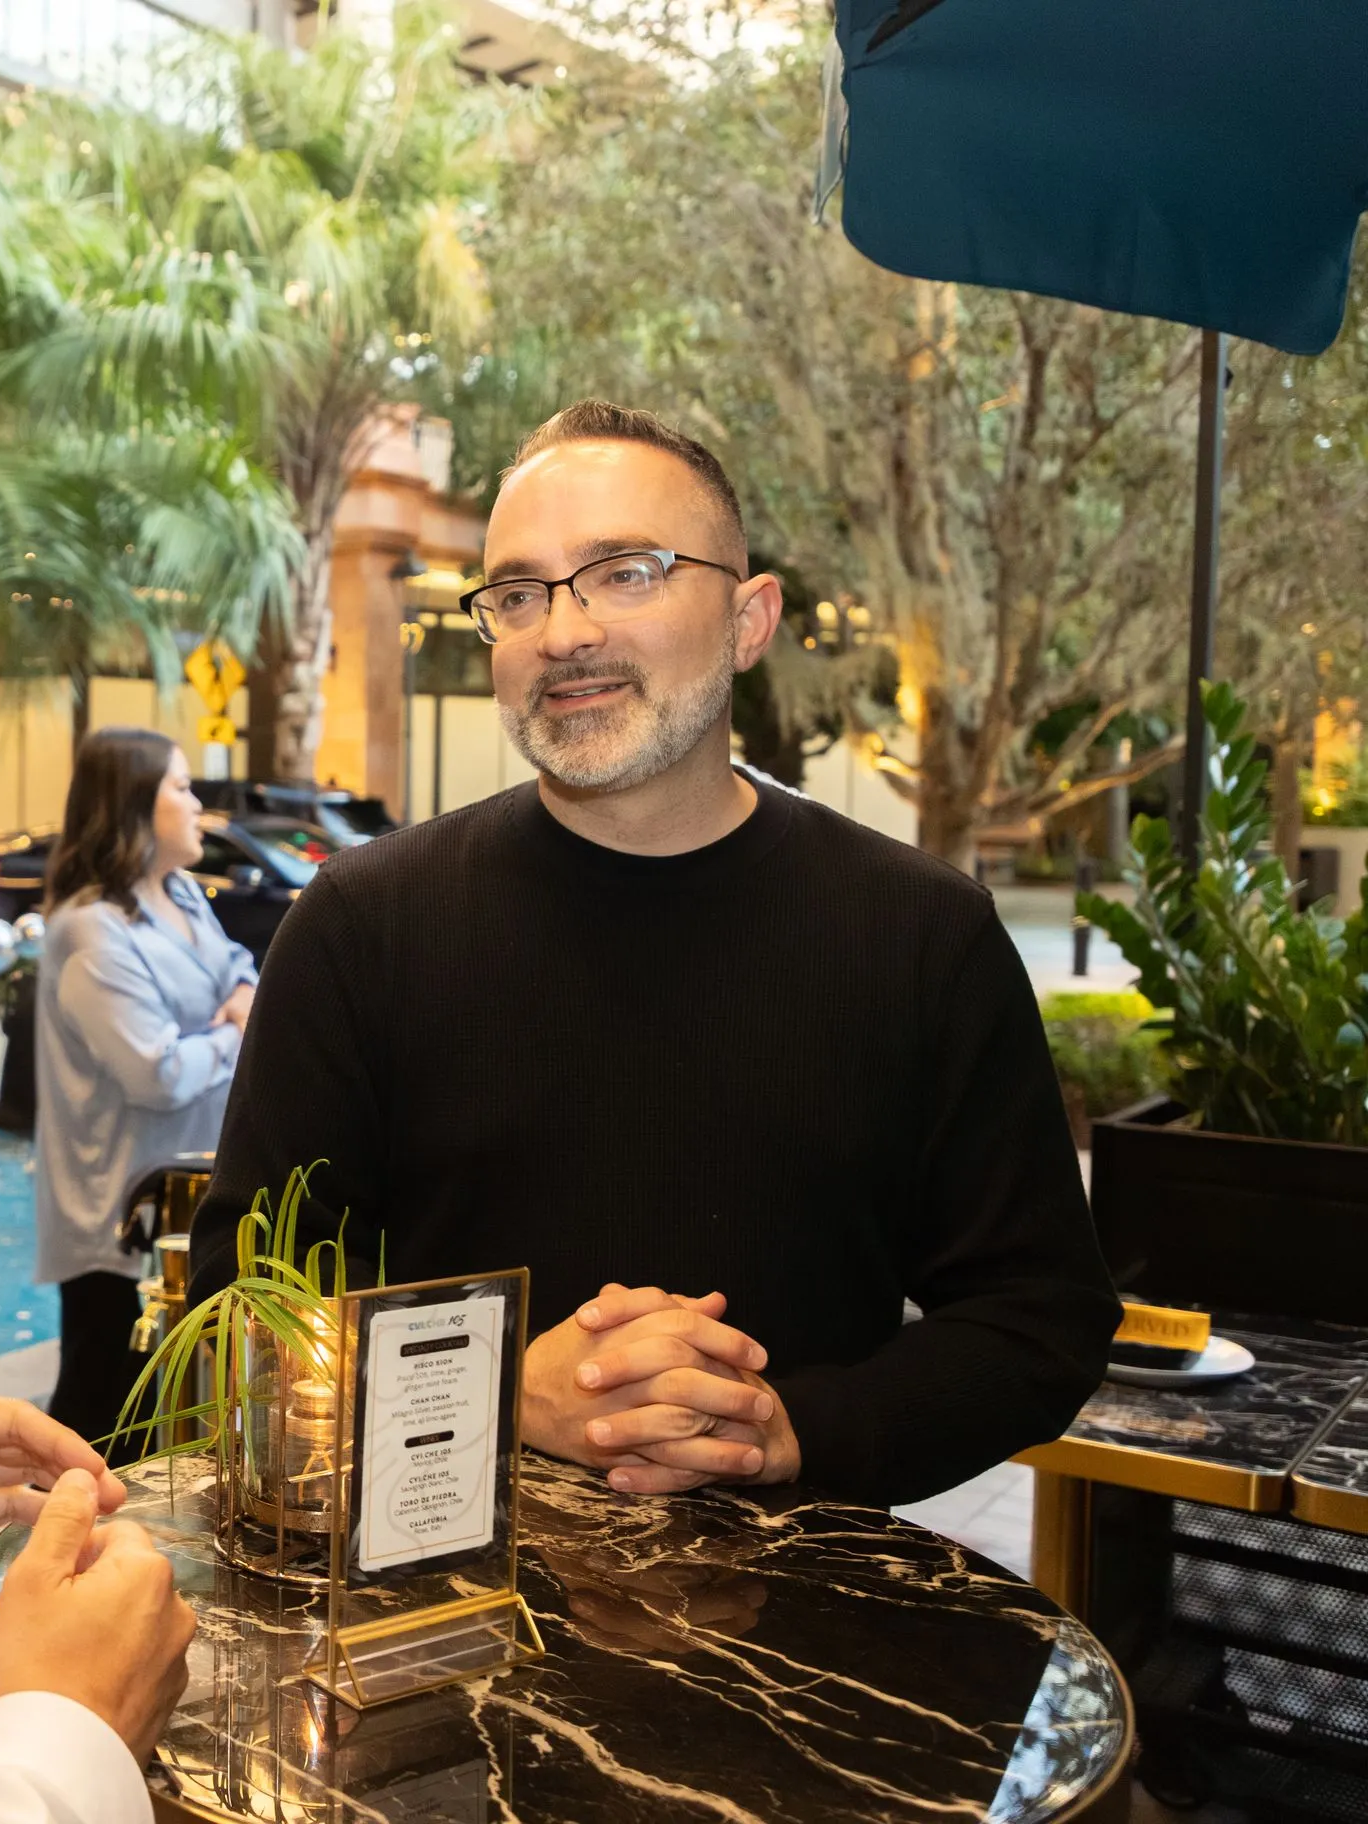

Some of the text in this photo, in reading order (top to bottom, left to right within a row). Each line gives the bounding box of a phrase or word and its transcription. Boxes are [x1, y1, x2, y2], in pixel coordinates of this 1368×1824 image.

[448, 1314, 466, 1327] 105
[414, 1360, 433, 1370] PISCO
[404, 1384, 424, 1394] ginger
[410, 1393, 450, 1405] CHAN CHAN
[434, 1456, 448, 1464] Chile
[400, 1484, 427, 1493] Sauvignon
[445, 1476, 459, 1484] Chile
[400, 1492, 457, 1508] TORO DE PIEDRA
[393, 1506, 420, 1516] Cabernet
[409, 1515, 447, 1528] CALAFURIA
